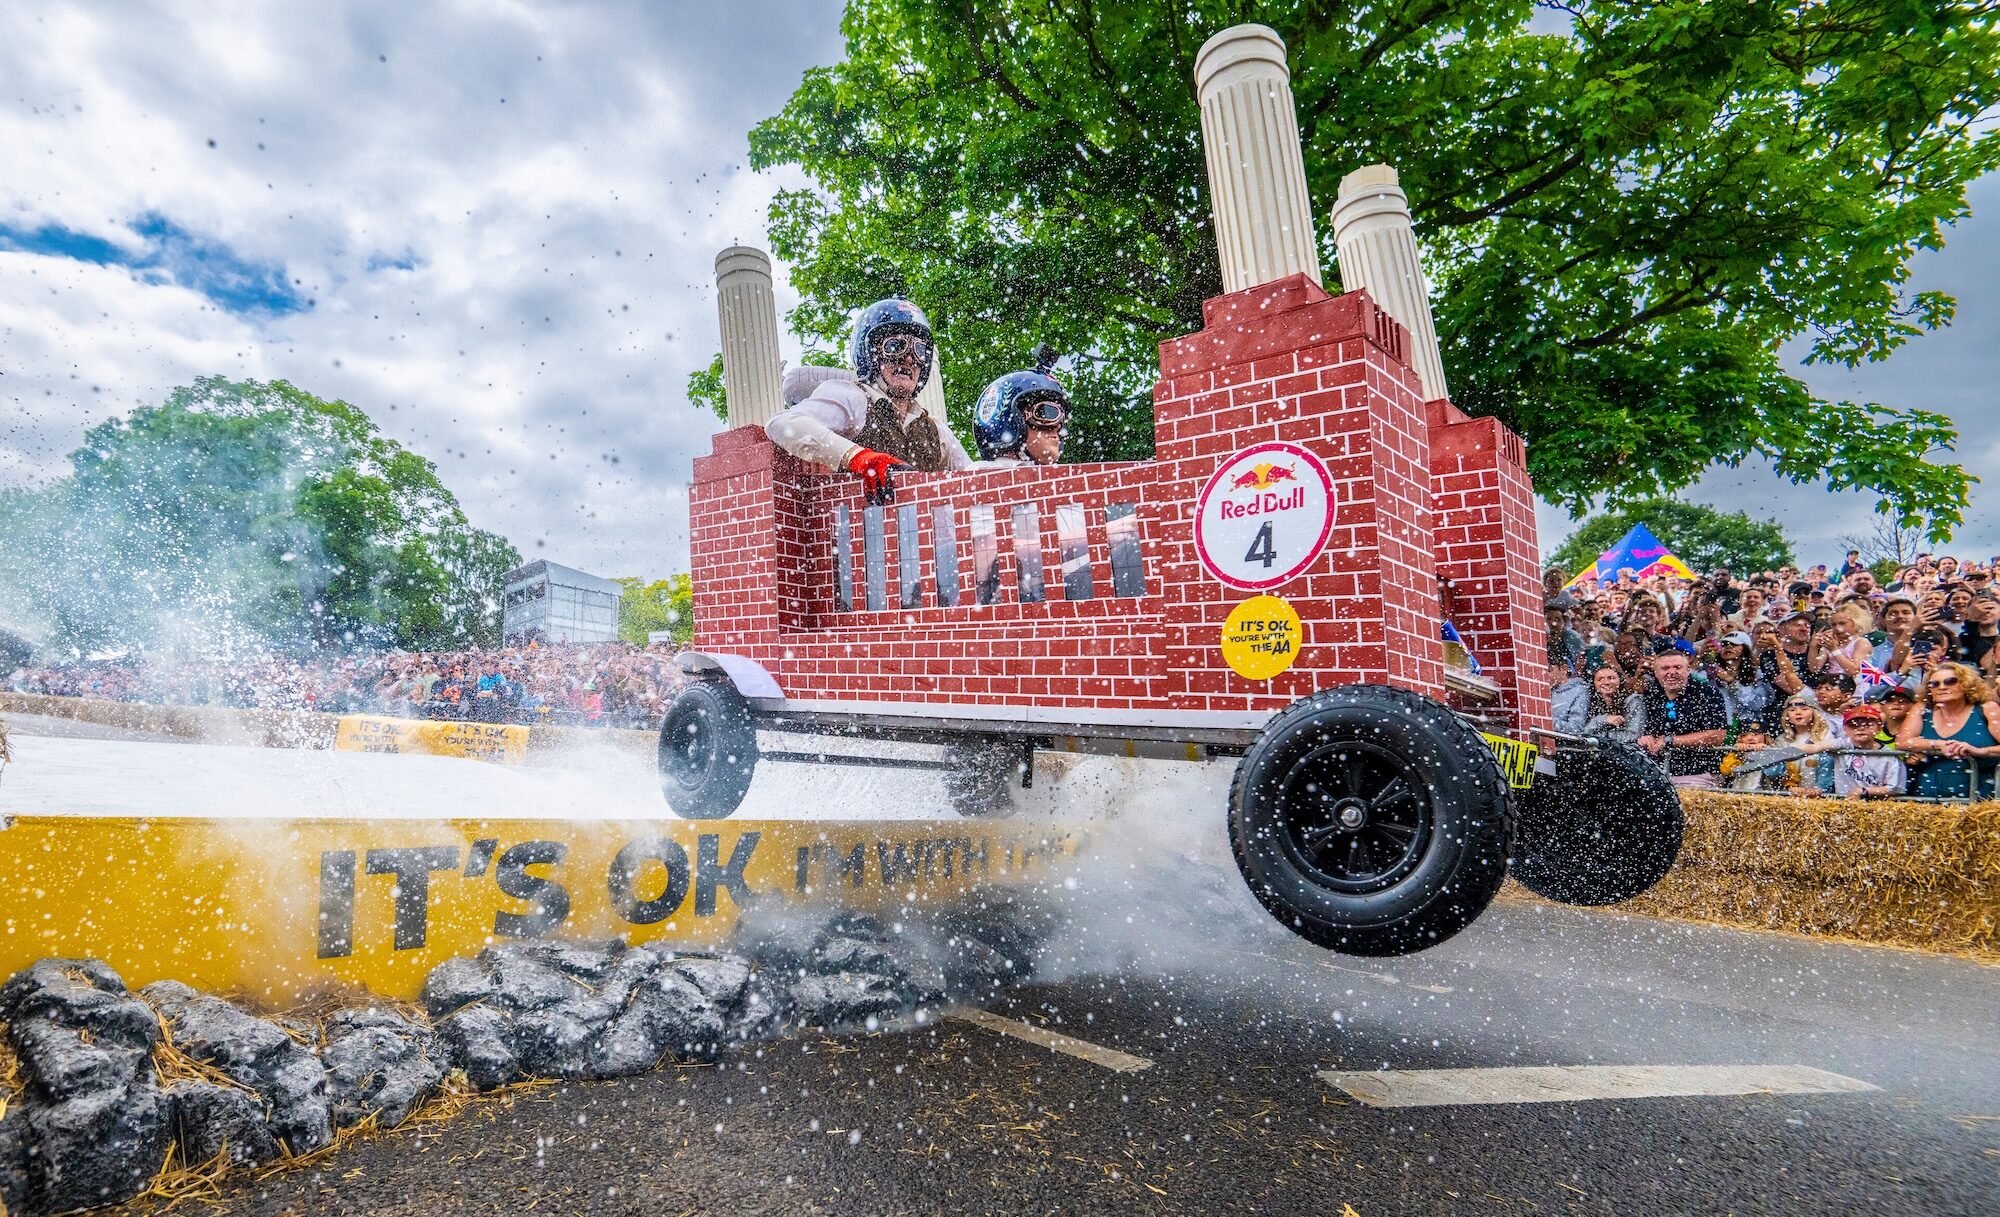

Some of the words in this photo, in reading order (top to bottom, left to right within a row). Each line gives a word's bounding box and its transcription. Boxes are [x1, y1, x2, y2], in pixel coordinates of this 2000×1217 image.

[1221, 494, 1260, 520] Red
[1264, 486, 1304, 513] Bull
[1244, 520, 1277, 568] 4
[1240, 620, 1264, 631] IT'S
[1268, 620, 1293, 631] OK.
[1229, 634, 1260, 643] YOU'RE
[1251, 642, 1273, 653] THE
[1272, 640, 1291, 656] AA
[317, 839, 571, 959] IT'S
[608, 832, 762, 925] OK
[878, 836, 990, 886] WITH
